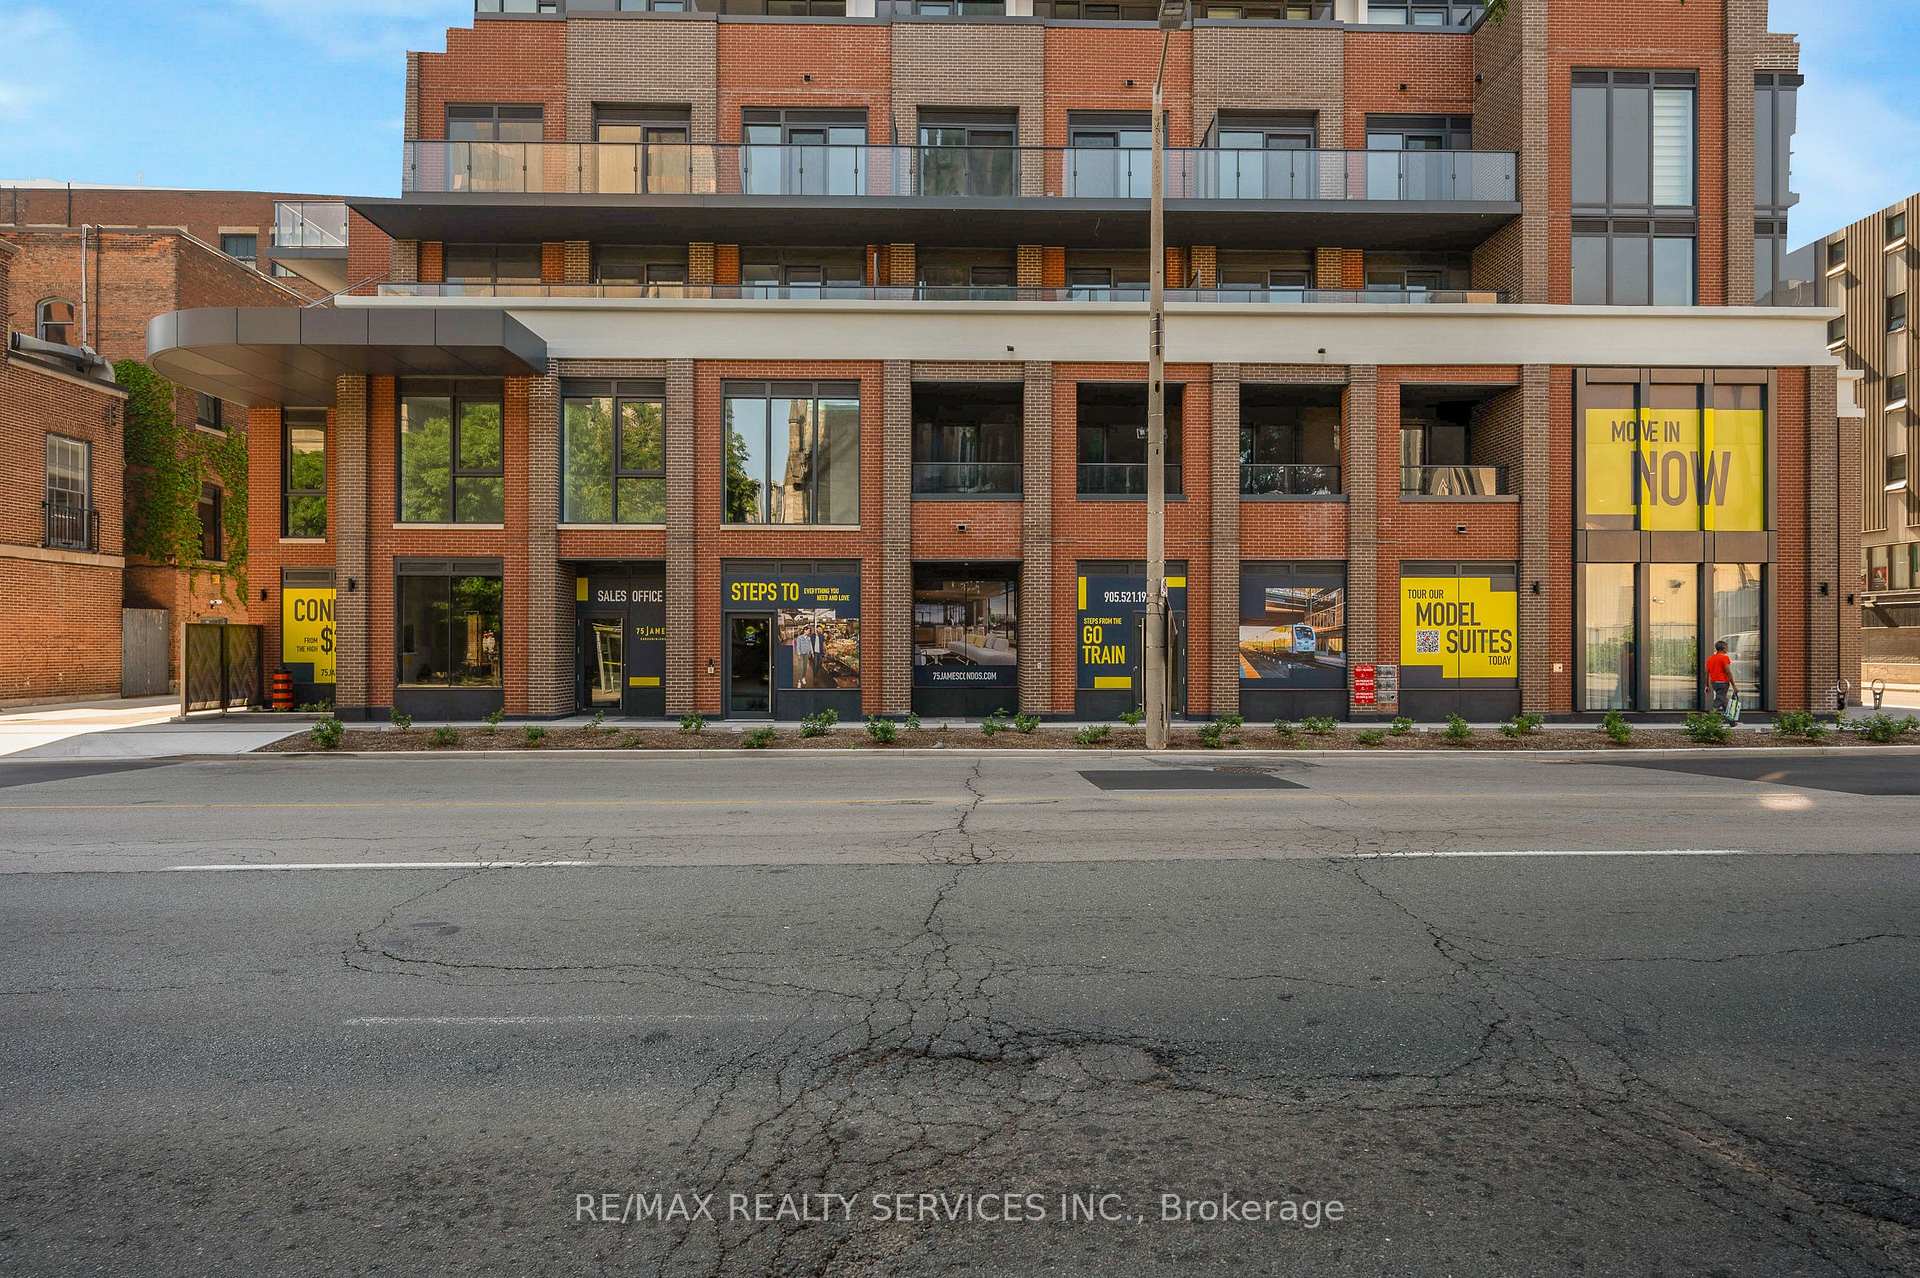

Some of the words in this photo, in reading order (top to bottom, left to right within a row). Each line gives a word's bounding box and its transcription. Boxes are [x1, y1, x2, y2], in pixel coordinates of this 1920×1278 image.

[1611, 420, 1658, 442] MOVE
[1664, 420, 1680, 442] IN
[1631, 450, 1731, 506] NOW
[597, 590, 627, 602] SALES
[632, 590, 663, 602] OFFICE
[731, 582, 777, 601] STEPS
[781, 582, 799, 601] TO
[803, 587, 830, 595] EVERYTHING
[1104, 591, 1147, 603] 905.521.19
[1408, 589, 1427, 599] TOUR
[1429, 589, 1444, 599] OUR
[1083, 617, 1098, 625] STEPS
[1099, 617, 1113, 625] FROM
[1113, 617, 1122, 625] THE
[1416, 602, 1481, 627] MODEL
[1083, 625, 1103, 644] GO
[1446, 629, 1512, 654] SUITES
[296, 645, 305, 653] THE
[1082, 645, 1126, 664] TRAIN
[1488, 655, 1511, 666] TODAY
